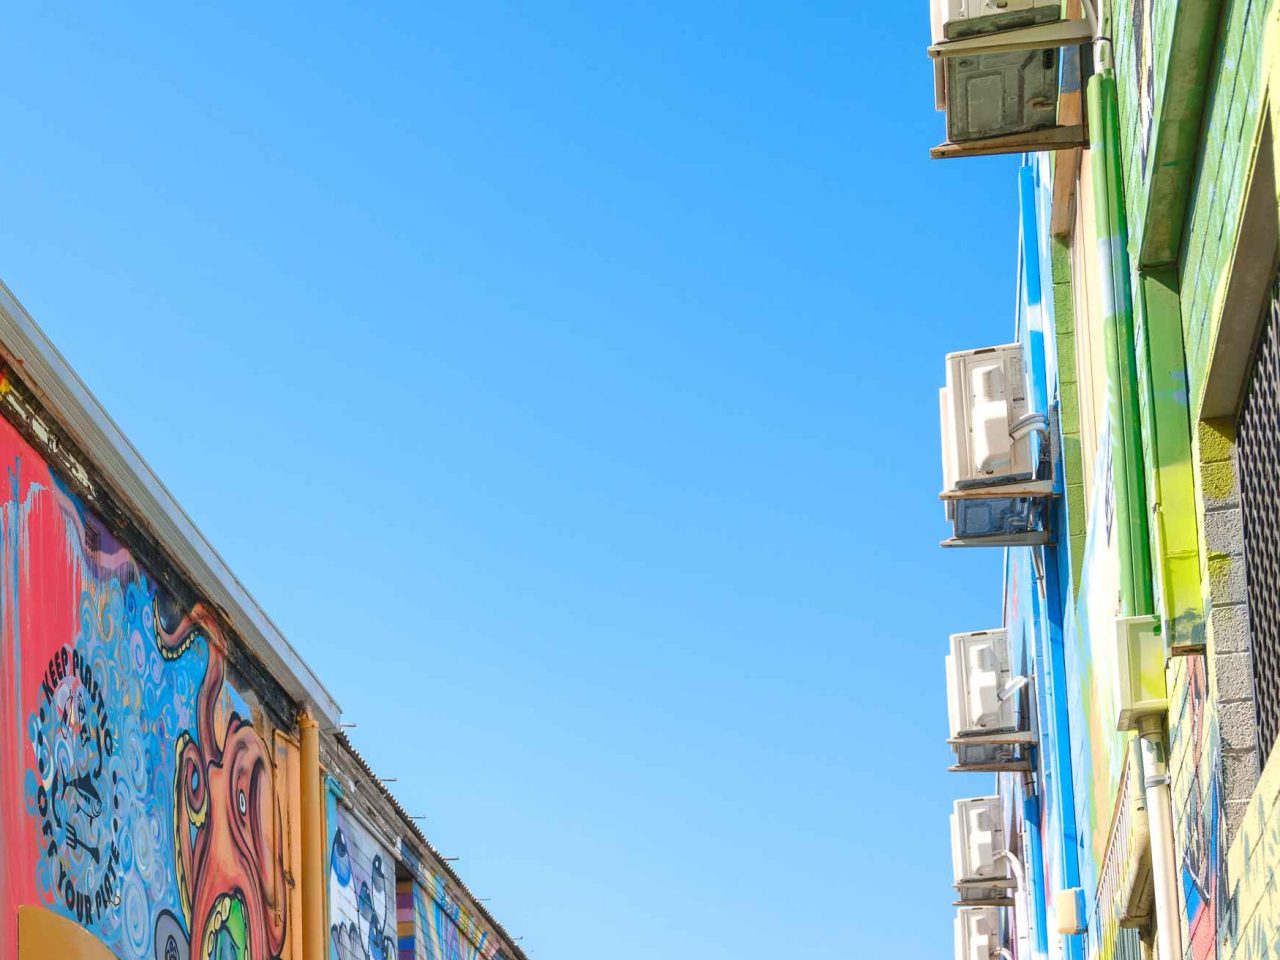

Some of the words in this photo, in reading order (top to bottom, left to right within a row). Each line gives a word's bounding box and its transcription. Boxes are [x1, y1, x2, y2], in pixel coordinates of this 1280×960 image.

[42, 646, 69, 706] KEEP
[72, 649, 113, 757] PLASTIC
[37, 784, 58, 859] OFF
[58, 859, 93, 925] YOUR
[95, 839, 121, 920] PLATE
